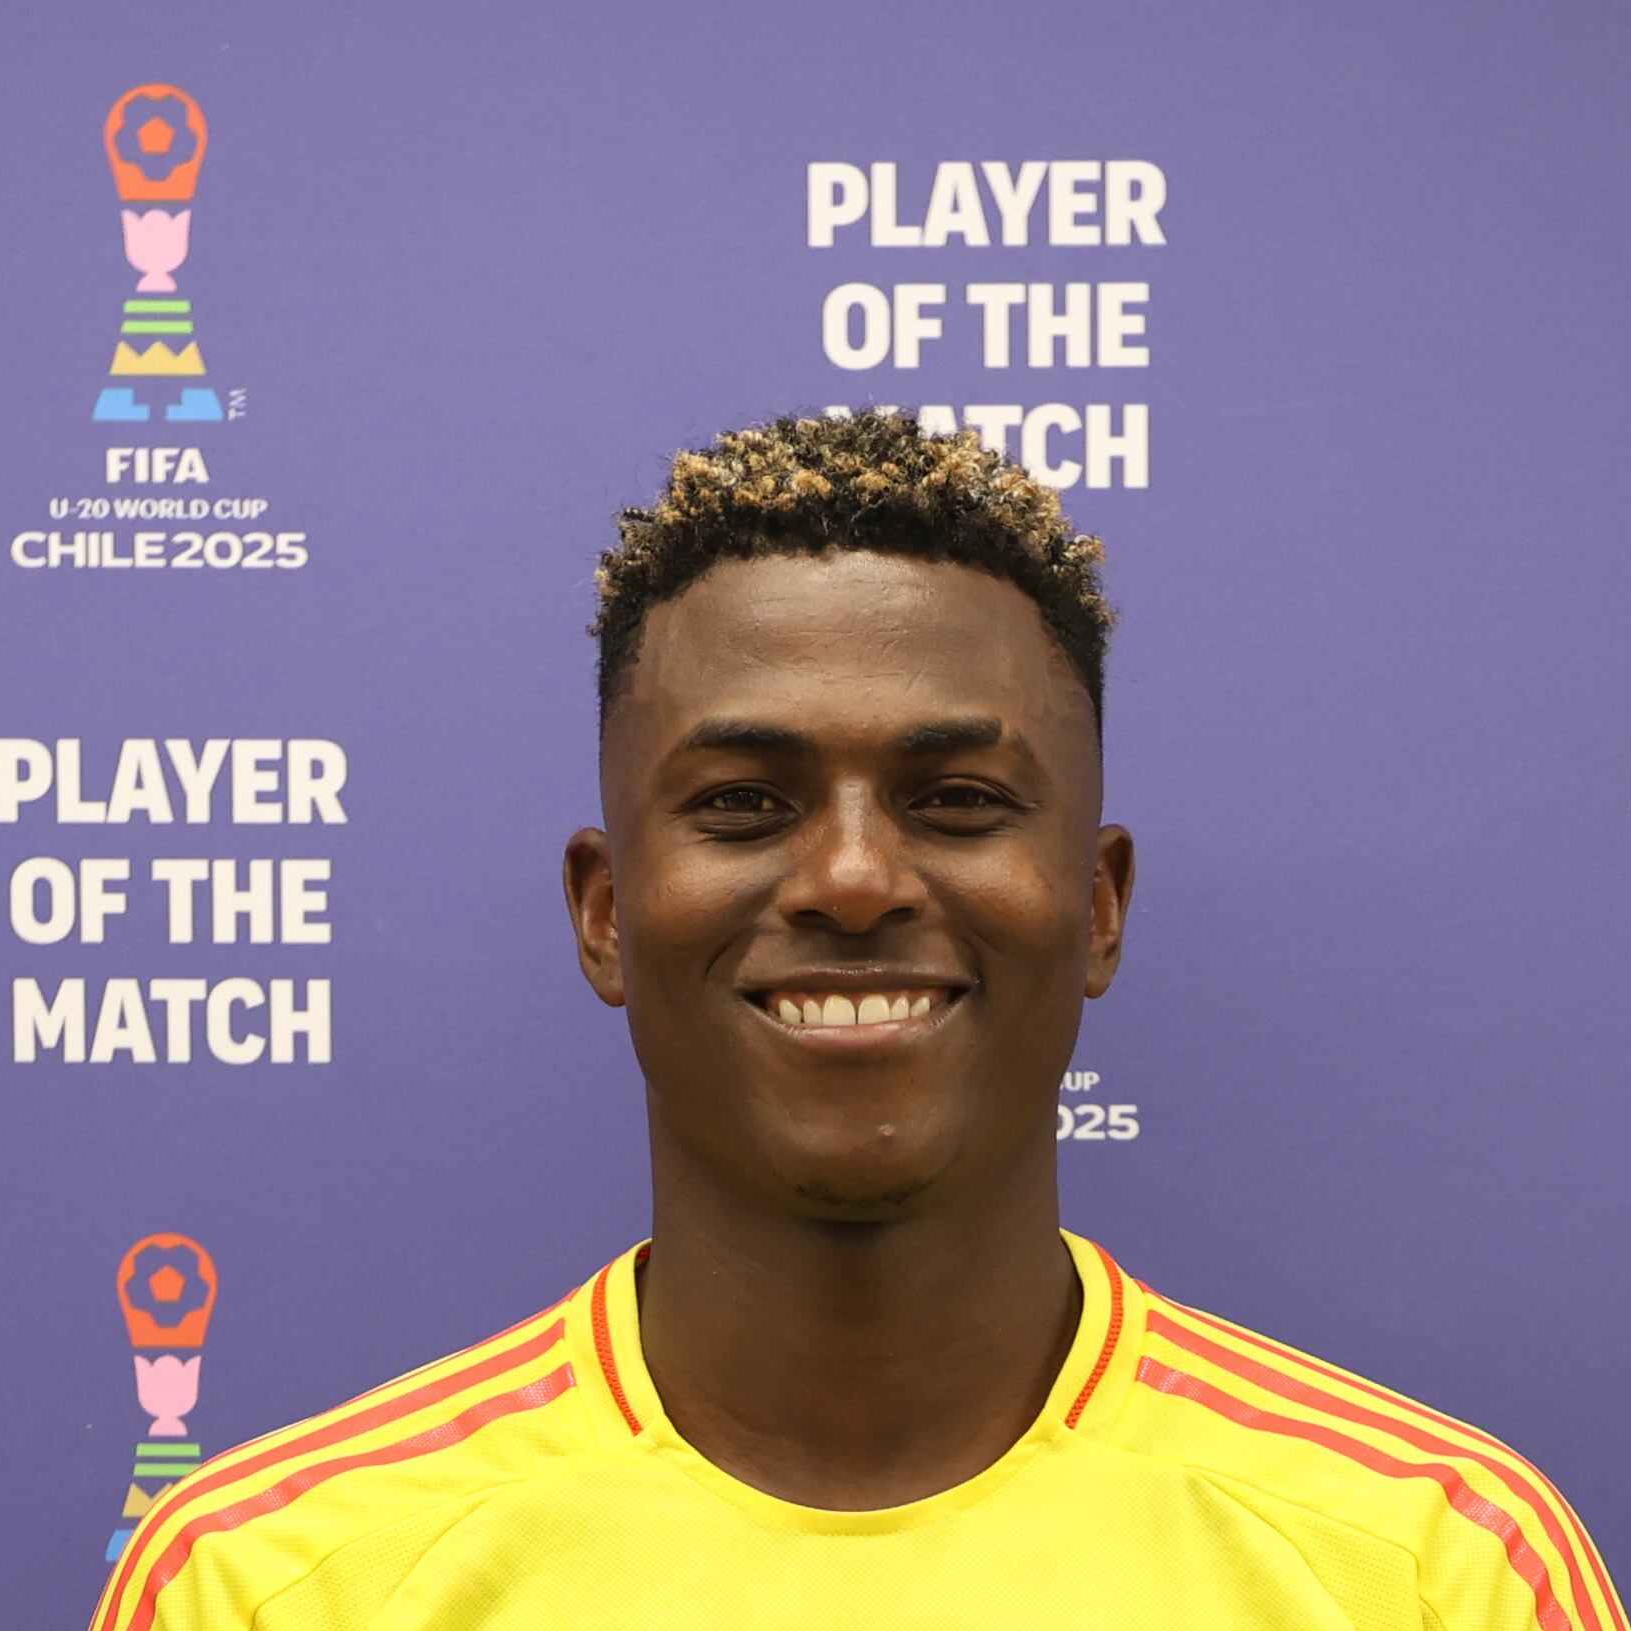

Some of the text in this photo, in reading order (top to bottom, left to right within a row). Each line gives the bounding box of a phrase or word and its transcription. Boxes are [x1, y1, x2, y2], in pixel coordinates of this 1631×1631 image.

[807, 160, 1167, 248] PLAYER
[822, 282, 1150, 371] OF THE
[49, 498, 268, 520] U-20 WORLD CUP
[106, 447, 210, 484] FIFA
[10, 857, 332, 945] OF THE
[13, 977, 331, 1065] MATCH
[1060, 1071, 1101, 1092] UP
